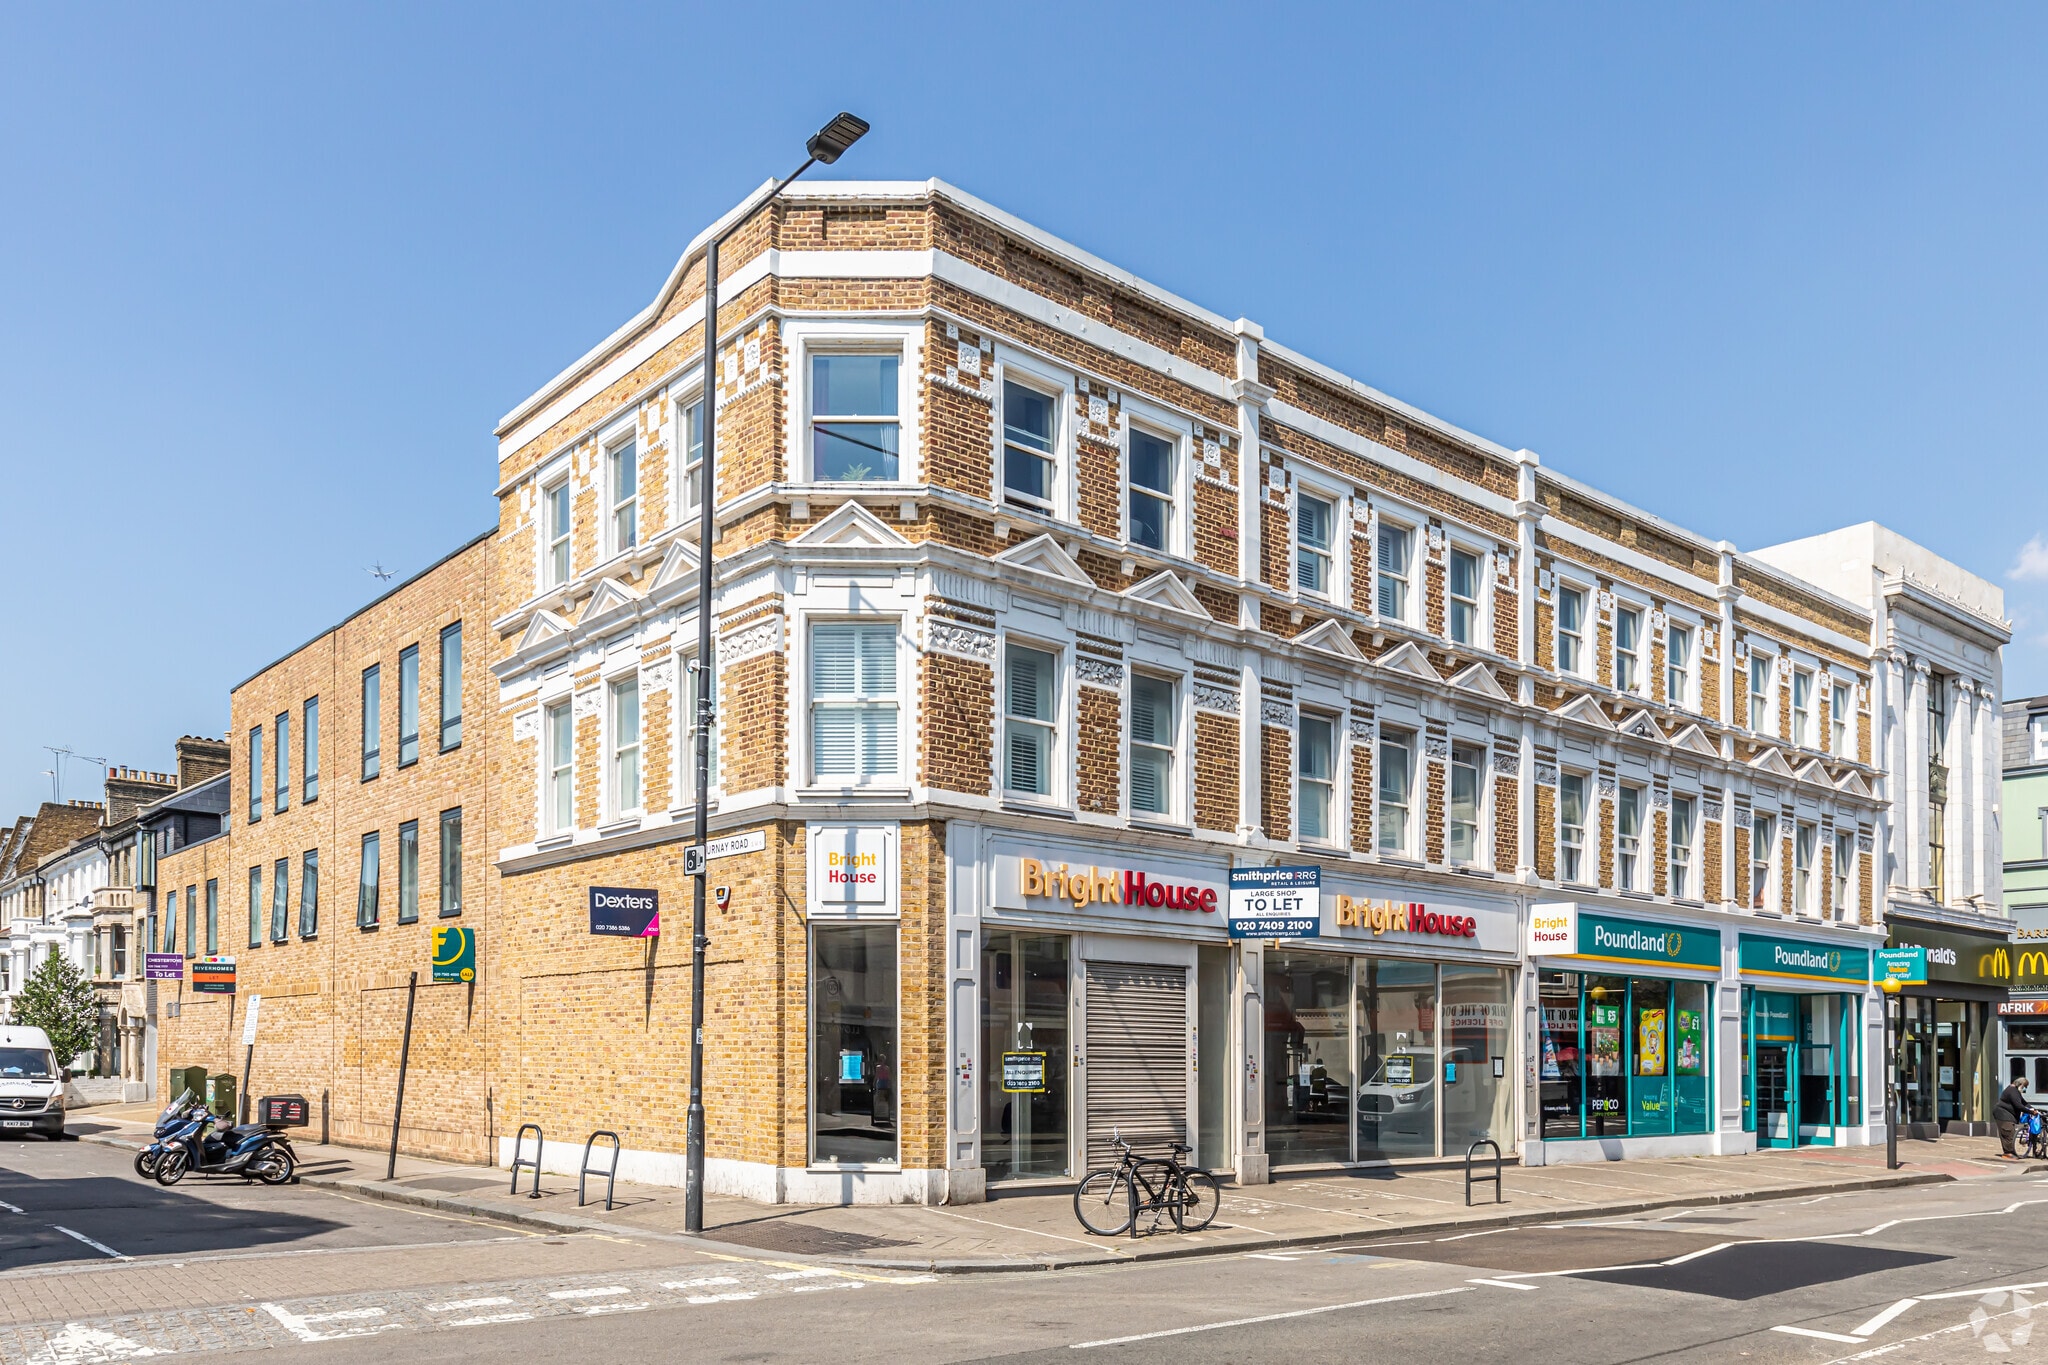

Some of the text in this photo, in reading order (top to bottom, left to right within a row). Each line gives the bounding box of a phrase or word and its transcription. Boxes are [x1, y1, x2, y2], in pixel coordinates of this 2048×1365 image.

[706, 841, 729, 855] URNAY
[730, 838, 749, 851] ROAD
[829, 852, 876, 868] Bright
[829, 870, 876, 883] House
[1232, 870, 1317, 883] smithprice RRG
[595, 892, 653, 909] Dexters
[1244, 898, 1303, 911] TO LET
[1236, 921, 1313, 930] 020 7409 2100
[1534, 917, 1568, 930] Bright
[1534, 931, 1568, 942] House
[1595, 924, 1665, 952] Poundland
[1775, 945, 1828, 969] Poundland
[2000, 1002, 2034, 1013] AFRIK
[1641, 1100, 1660, 1111] Value
